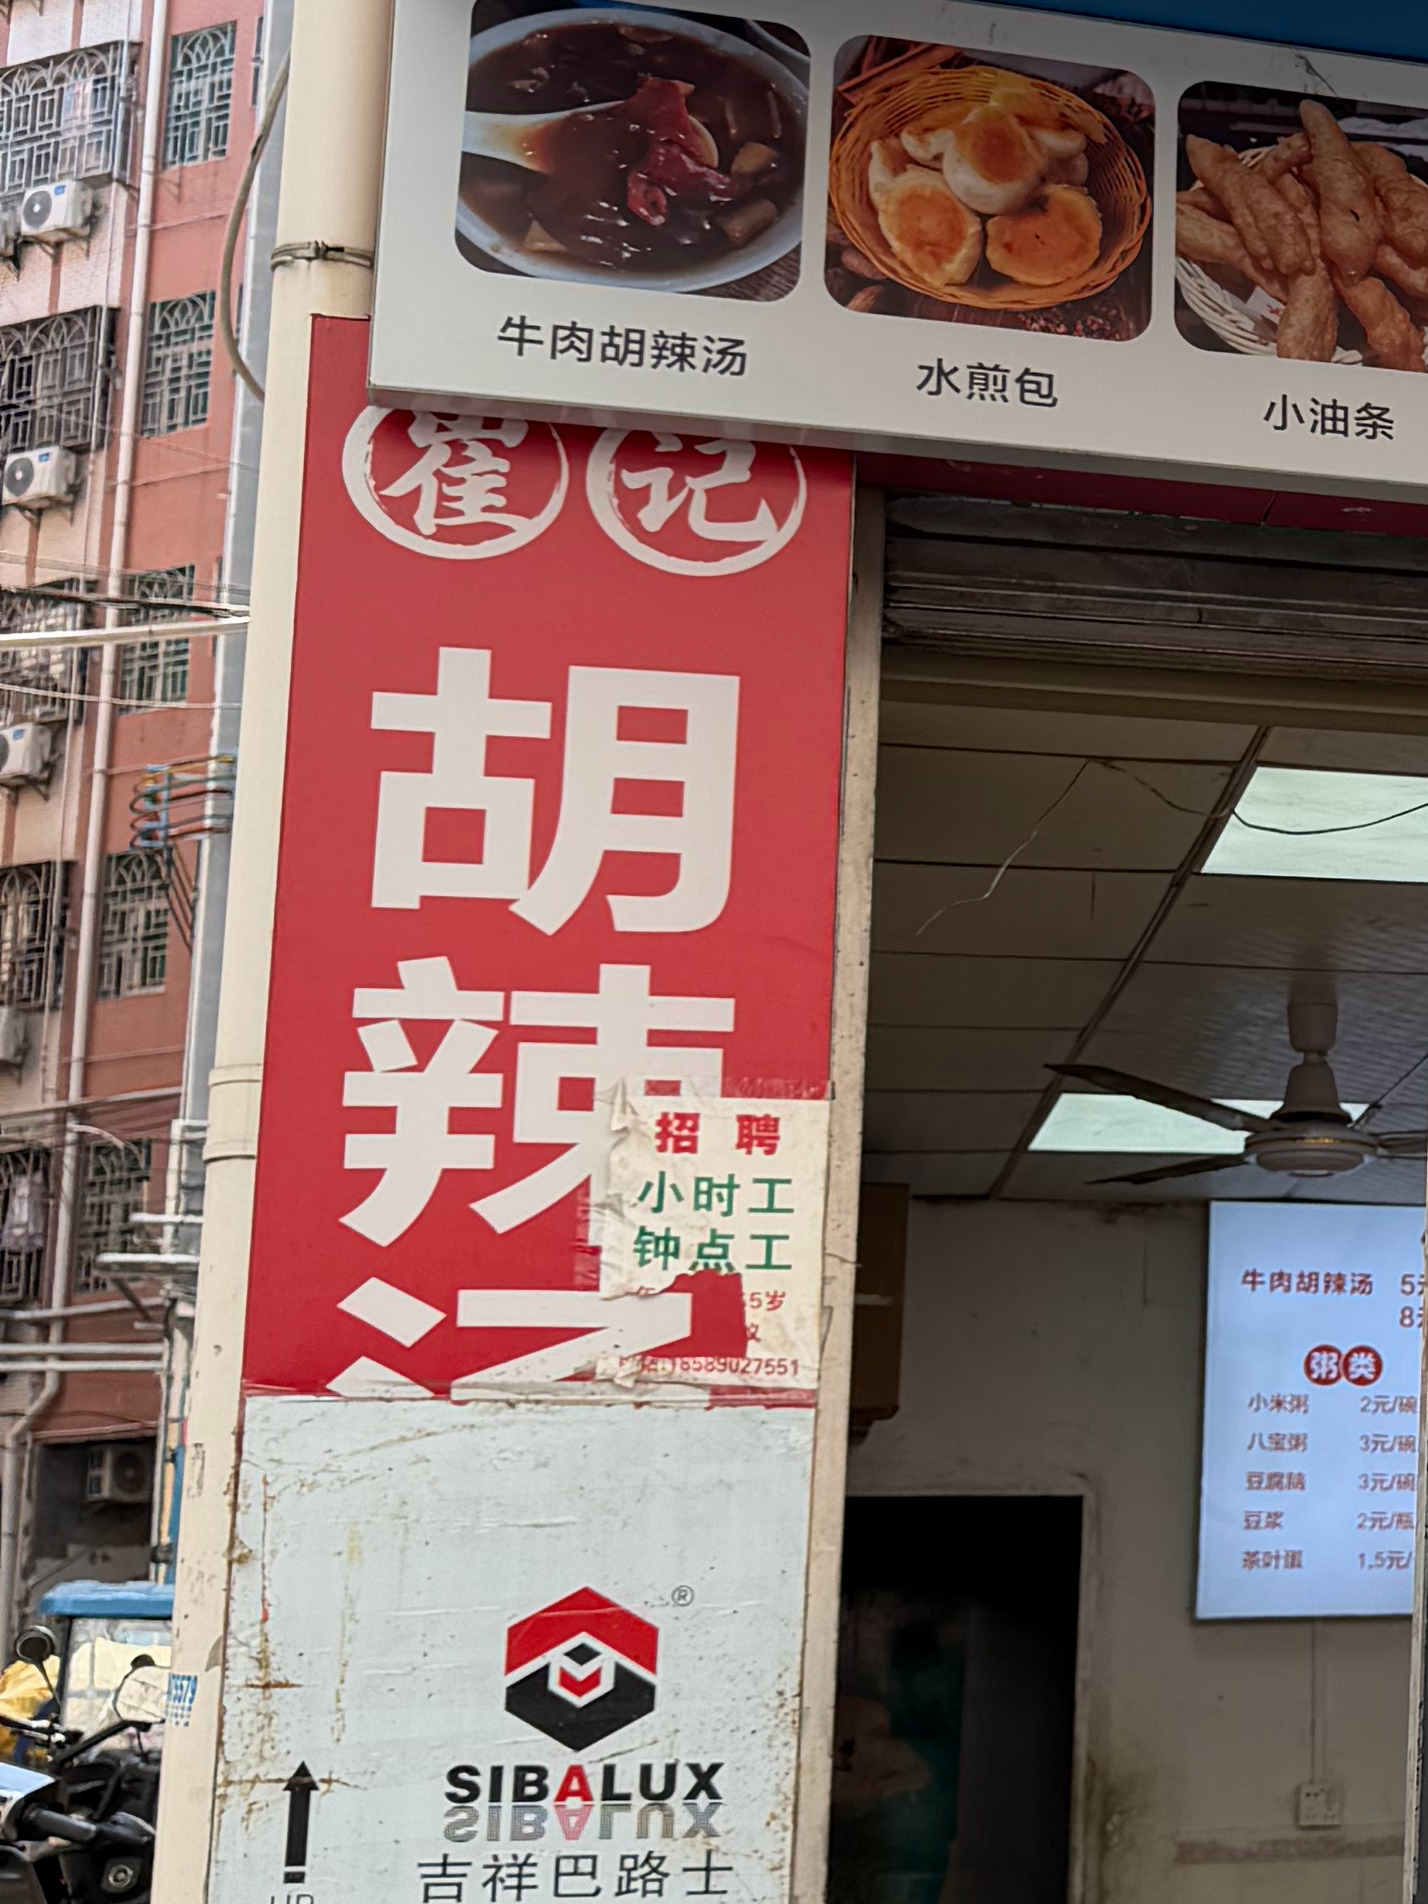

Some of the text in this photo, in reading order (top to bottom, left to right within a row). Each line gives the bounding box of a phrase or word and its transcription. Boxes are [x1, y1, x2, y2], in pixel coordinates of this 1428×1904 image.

[497, 314, 749, 379] 牛肉胡辣汤
[916, 357, 1059, 409] 水煎包
[1263, 393, 1396, 442] 小油条
[655, 1112, 781, 1156] 招聘
[637, 1171, 795, 1217] 小时工
[633, 1226, 792, 1273] 钟点工
[1241, 1269, 1373, 1296] 牛肉胡辣汤
[1309, 1350, 1378, 1381] 粥类
[1247, 1394, 1309, 1415] 小米粥
[1247, 1432, 1308, 1453] 八宝粥
[1243, 1512, 1283, 1531] 豆浆
[1358, 1552, 1413, 1570] 1.5元/
[444, 1762, 724, 1805] SIBALUX
[417, 1849, 735, 1904] 吉祥巴路士
